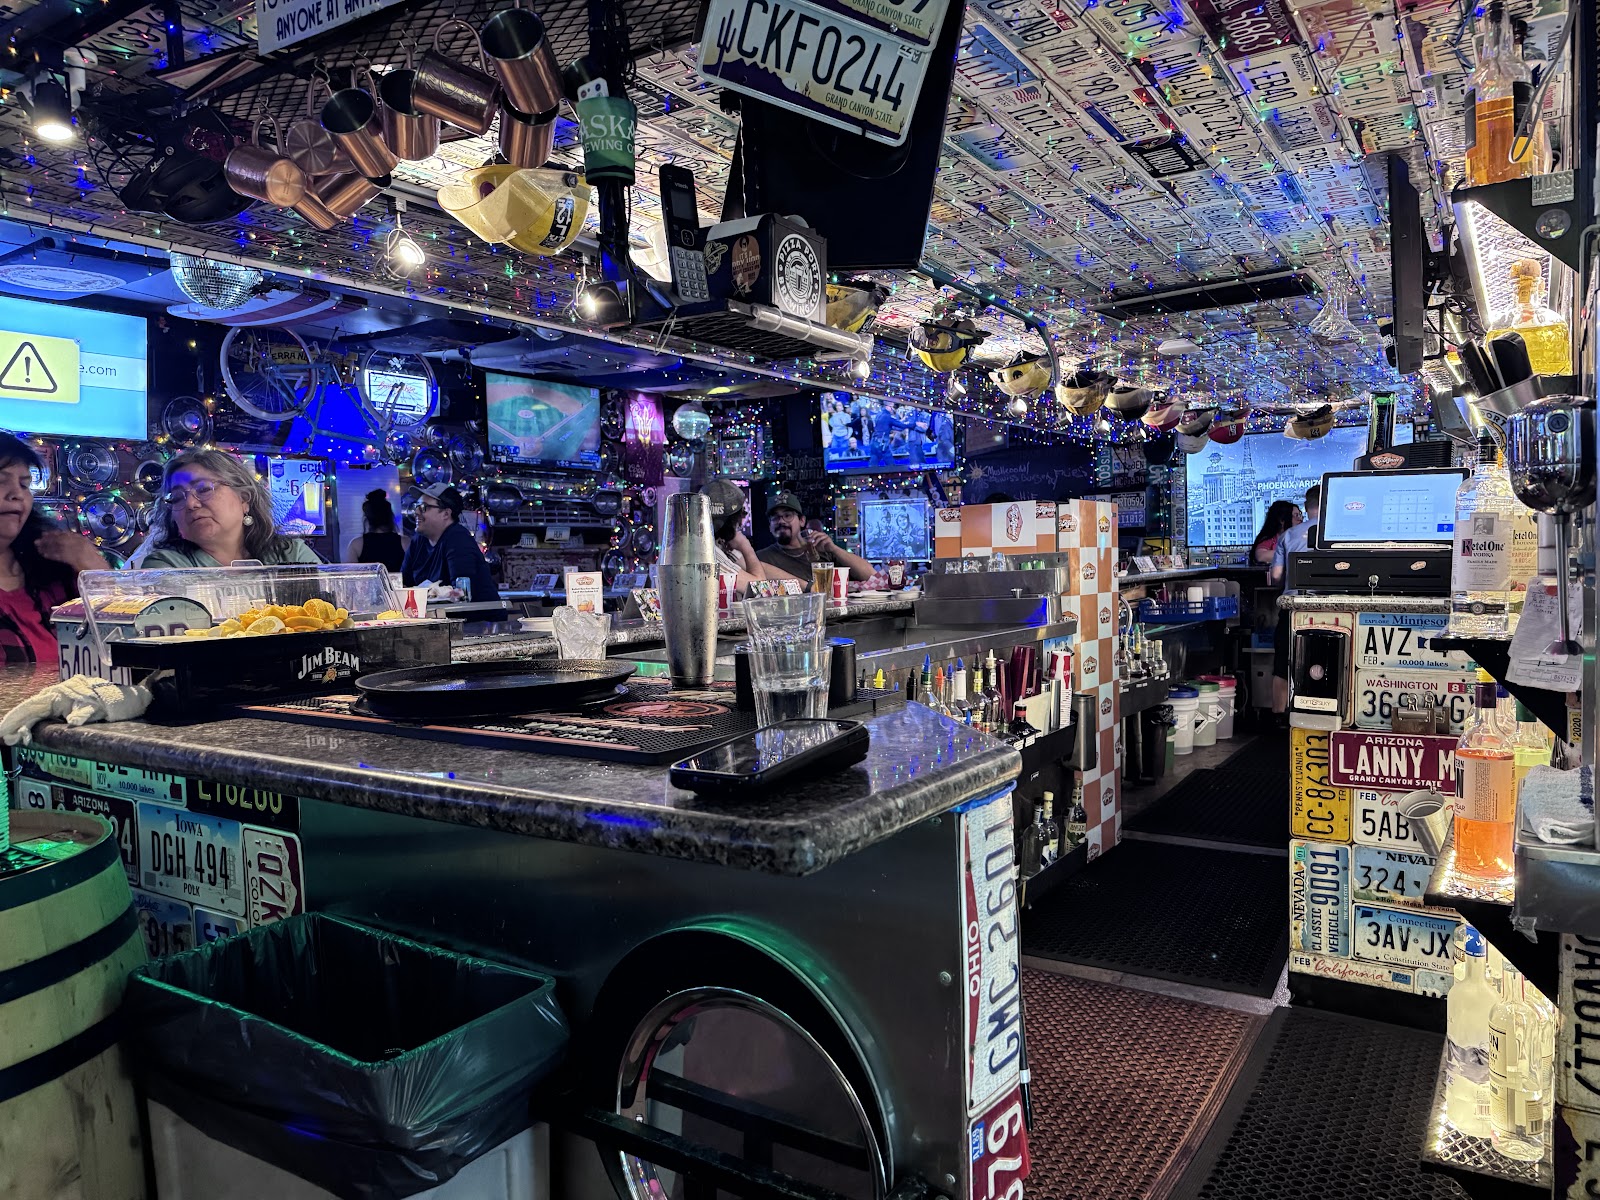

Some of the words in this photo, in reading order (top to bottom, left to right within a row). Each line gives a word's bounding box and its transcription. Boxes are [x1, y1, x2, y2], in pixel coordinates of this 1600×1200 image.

[276, 3, 322, 41] ANYONE
[326, 0, 339, 21] AT
[876, 3, 902, 20] CANYON
[903, 14, 922, 29] STATE
[968, 0, 997, 23] EVERGREEN
[992, 21, 1010, 34] STATE
[1096, 15, 1120, 34] HARRISON
[737, 0, 905, 112] CKF0244
[1038, 38, 1094, 69] 7XH
[1069, 70, 1123, 98] 198
[1101, 57, 1124, 74] YORK
[1285, 51, 1315, 82] NEBRASKA
[1150, 50, 1222, 103] AAN6149
[1331, 60, 1398, 113] BEG-141
[1387, 75, 1409, 99] HAMPSHIRE
[826, 92, 848, 109] GRAND
[849, 100, 874, 119] CANYON
[875, 110, 893, 125] STATE
[992, 95, 1011, 108] TRUST
[1093, 93, 1141, 118] DCE
[1110, 112, 1162, 140] 1706
[1200, 113, 1252, 143] 2146
[1533, 171, 1573, 192] HUSS
[781, 239, 802, 262] PIZZA
[804, 246, 819, 281] PORT
[778, 276, 810, 315] BREWING
[1462, 540, 1487, 554] Ketel
[1487, 541, 1505, 551] One
[1364, 626, 1412, 657] AVZ
[298, 653, 322, 680] JIM
[325, 646, 360, 672] BEAM
[1363, 655, 1378, 665] FEB
[1427, 660, 1449, 668] lakes
[1366, 679, 1438, 691] WASHINGTON
[1452, 683, 1459, 692] 8
[1366, 736, 1424, 747] ARIZONA
[1573, 718, 1582, 739] 2020
[1339, 743, 1425, 779] LANNY
[97, 771, 108, 785] NOV
[138, 782, 156, 796] lakes
[1296, 752, 1304, 813] PENNSYLVANIA
[1349, 775, 1376, 783] GRAND
[1379, 776, 1413, 785] CANYON
[1415, 779, 1442, 788] STATE
[72, 793, 110, 813] ARIZONA
[1338, 789, 1347, 802] TR
[1359, 791, 1377, 801] FEB
[151, 830, 187, 880] DGH
[194, 840, 230, 890] 494
[183, 882, 201, 897] POLK
[984, 815, 1018, 953] 2601
[1310, 849, 1340, 906] 9091
[1360, 865, 1406, 896] 324
[1294, 869, 1305, 922] NEVADA
[1312, 907, 1322, 951] CLASSIC
[1328, 909, 1339, 953] VEHICLE
[1388, 913, 1447, 931] Connecticut
[1367, 921, 1411, 952] 3AV
[967, 920, 981, 998] OHIO
[1294, 957, 1311, 966] FEB
[1313, 955, 1387, 983] California
[1383, 953, 1429, 968] Constitution
[1431, 961, 1450, 971] State
[987, 962, 1020, 1076] GMC
